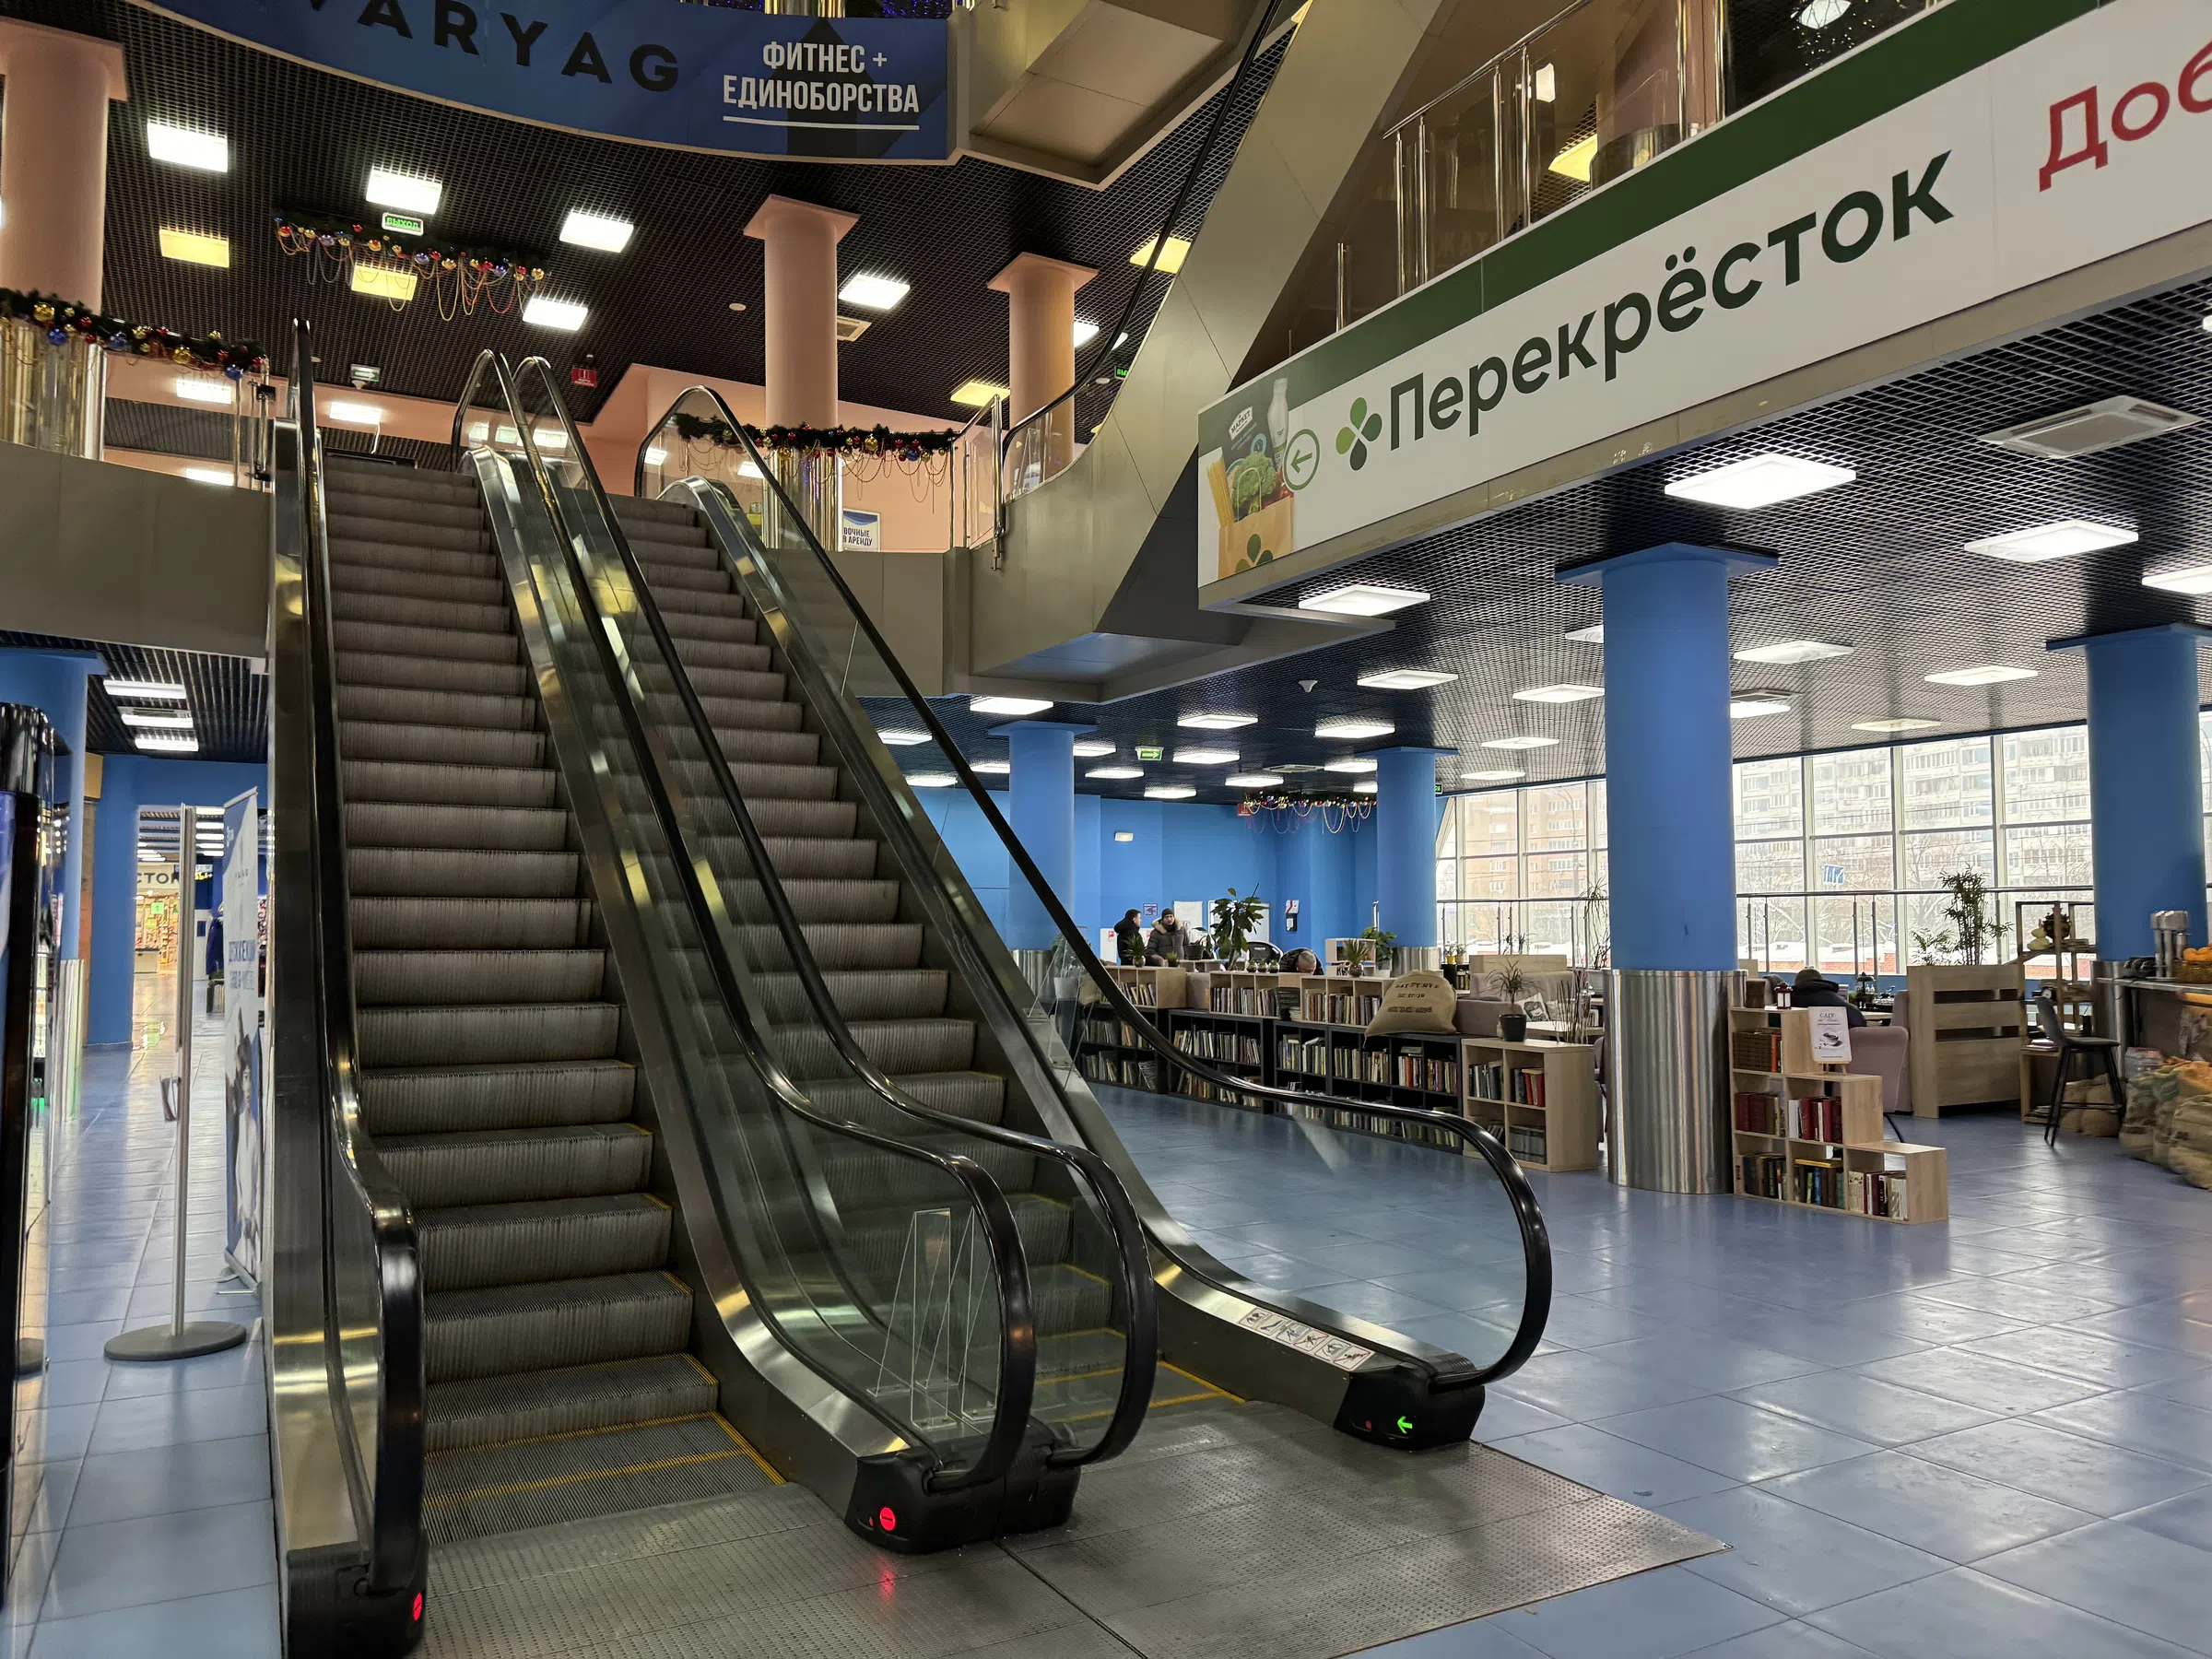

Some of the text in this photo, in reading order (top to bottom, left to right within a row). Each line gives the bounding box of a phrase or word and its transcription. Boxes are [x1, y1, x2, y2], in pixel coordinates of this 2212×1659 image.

[307, 0, 679, 92] ARYAG
[762, 41, 865, 74] ФИТНЕС
[723, 75, 920, 113] ЕДИНОБОРСТВА
[386, 217, 419, 230] ВЫХОД
[1390, 149, 1955, 452] Перекрёсток
[848, 535, 873, 547] АРЕНДУ
